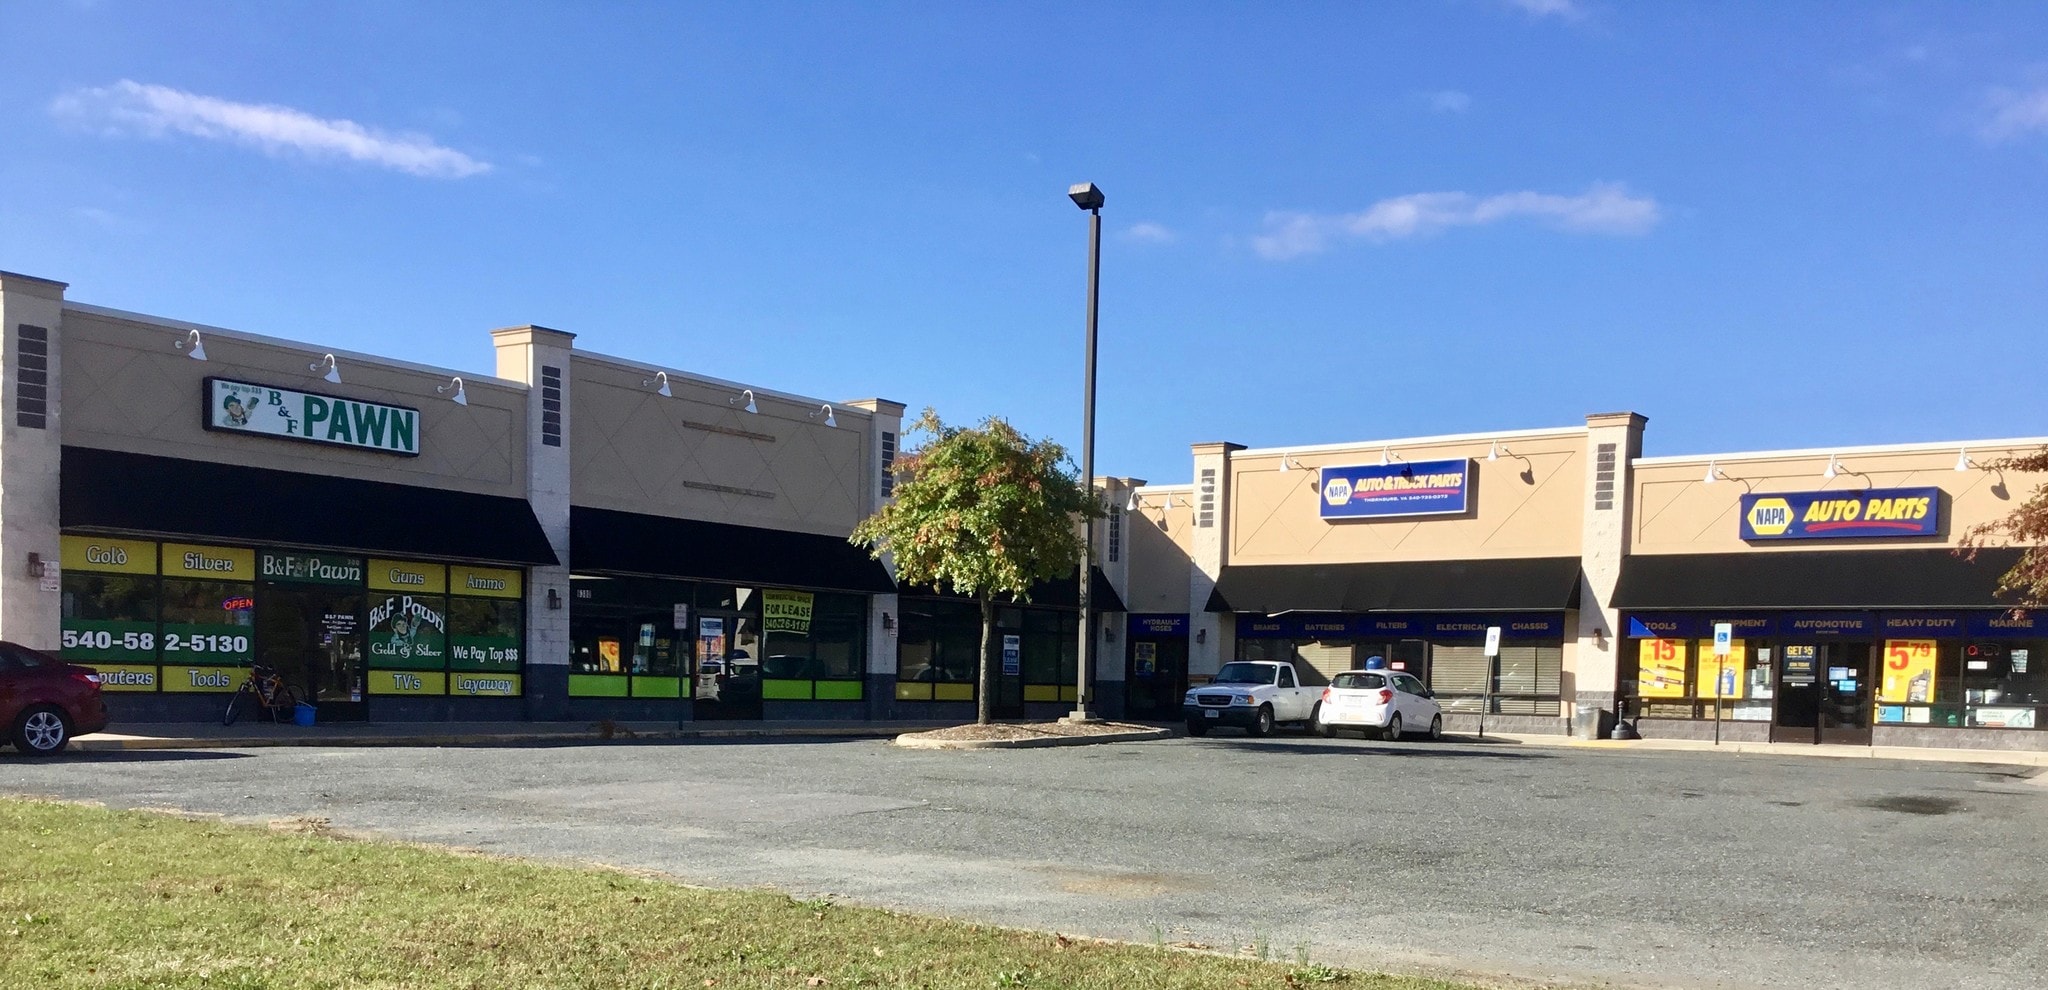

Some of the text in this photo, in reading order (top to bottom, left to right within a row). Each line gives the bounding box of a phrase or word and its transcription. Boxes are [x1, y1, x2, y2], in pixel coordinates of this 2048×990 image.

[303, 395, 414, 451] PAWN
[1328, 486, 1348, 498] NAPA
[1428, 473, 1463, 489] PARTS
[1756, 497, 1930, 525] NAPA AUTO PARTS
[86, 545, 128, 565] Gold
[184, 552, 234, 572] Silver
[262, 554, 361, 581] B&F Pawn
[389, 568, 425, 585] Guns
[466, 573, 505, 591] Ammo
[224, 598, 254, 611] OPEN
[765, 603, 811, 617] FOR LEASE
[402, 595, 444, 634] Pawn
[1304, 623, 1345, 631] BATTERIES
[1376, 621, 1407, 629] FILTERS
[1436, 623, 1487, 631] ELECTRICAL
[1511, 622, 1549, 630] CHASSIS
[1645, 622, 1677, 630] TOOLS
[1794, 620, 1863, 629] AUTOMOTIVE
[1886, 619, 1956, 627] HEAVY DUTY
[1989, 619, 2033, 628] MARINE
[371, 642, 396, 656] Gold
[415, 643, 442, 658] Silver
[453, 645, 518, 664] We Pay Top $$$
[1787, 646, 1813, 656] GET $5
[98, 670, 154, 685] puters
[188, 670, 230, 687] Tools
[393, 674, 421, 690] TV's
[457, 675, 513, 695] Layaway
